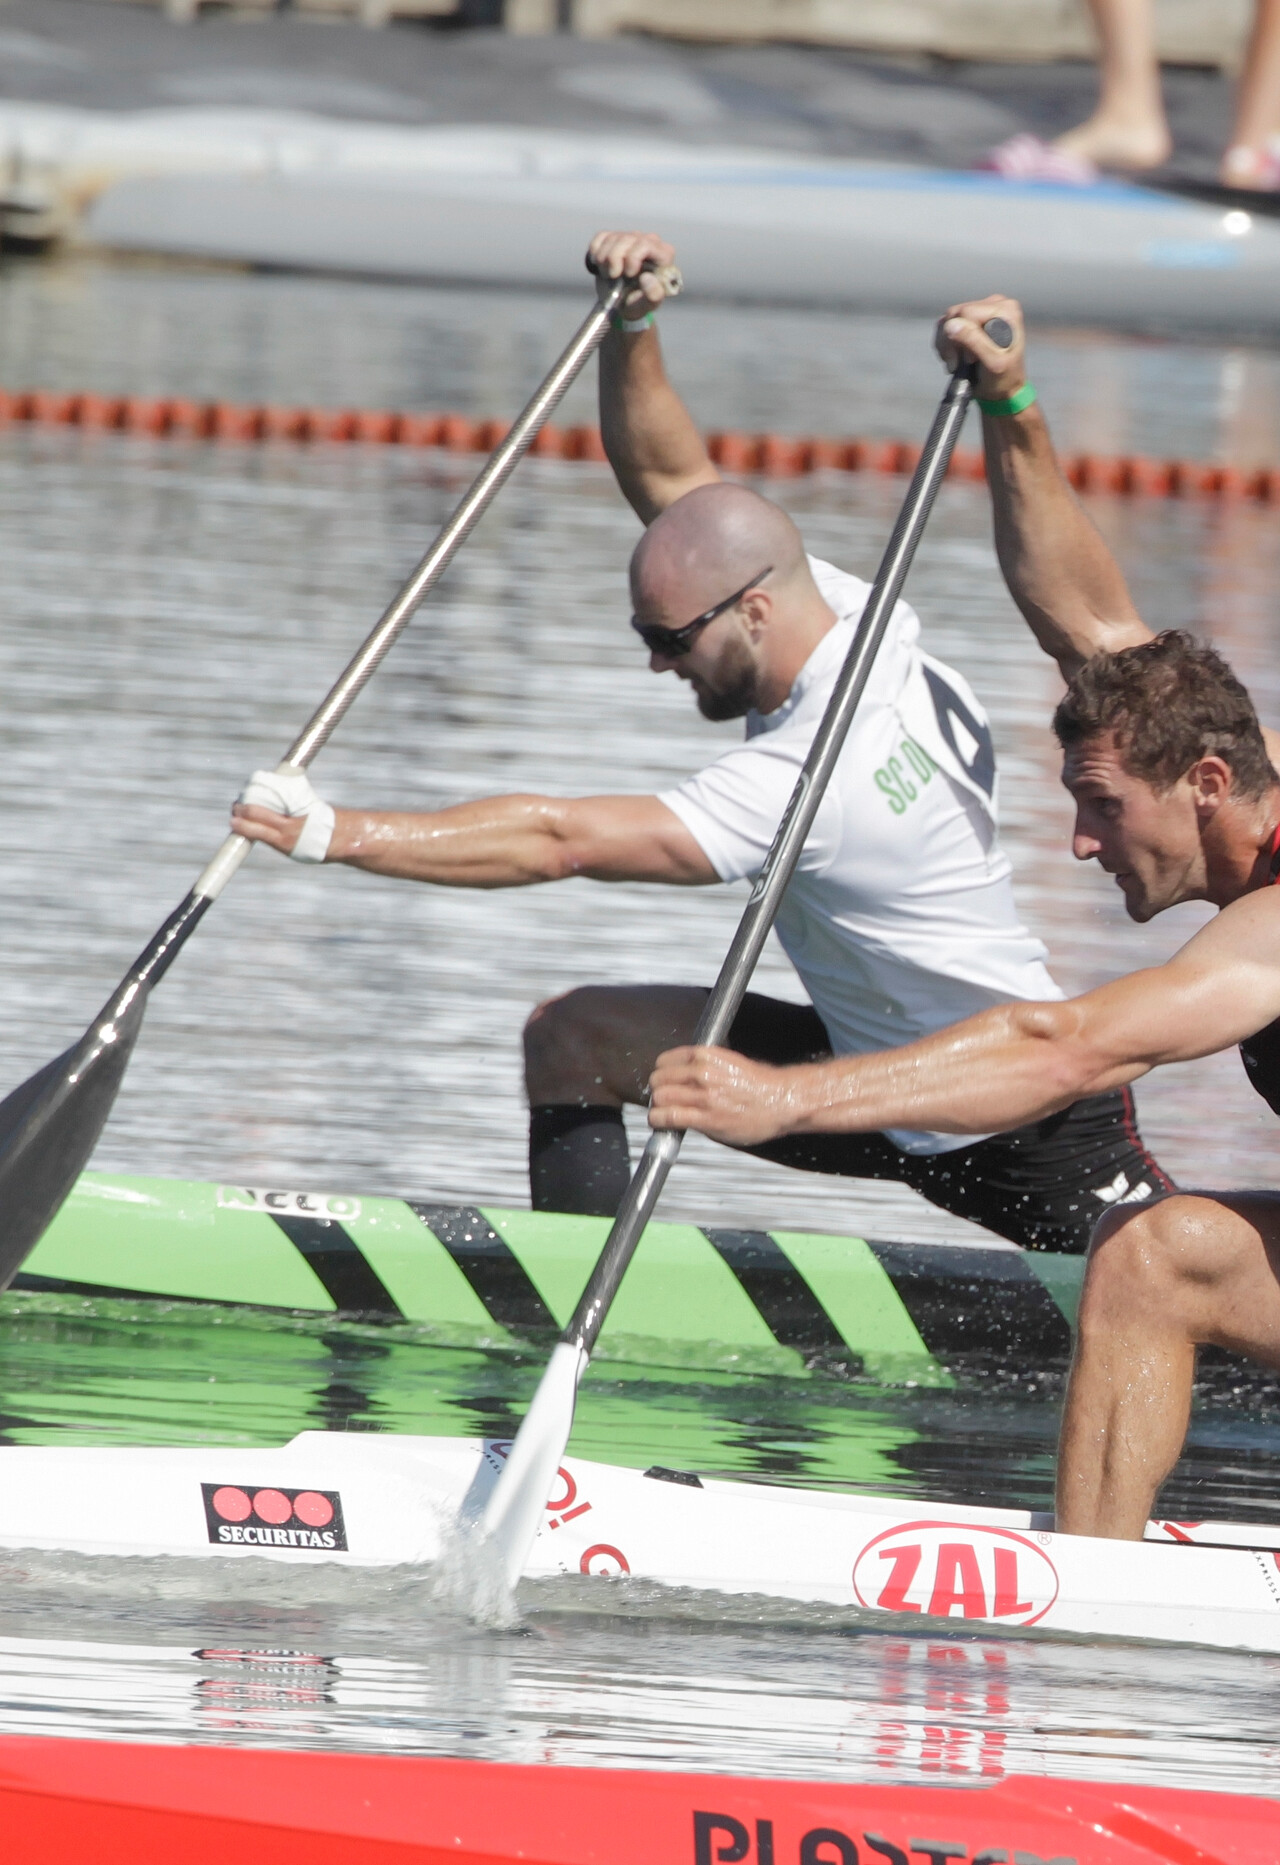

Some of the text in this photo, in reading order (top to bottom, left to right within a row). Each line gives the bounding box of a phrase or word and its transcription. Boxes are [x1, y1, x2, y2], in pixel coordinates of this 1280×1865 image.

[873, 755, 918, 815] SC
[218, 1525, 336, 1548] SECURITAS
[877, 1543, 1033, 1619] ZAL
